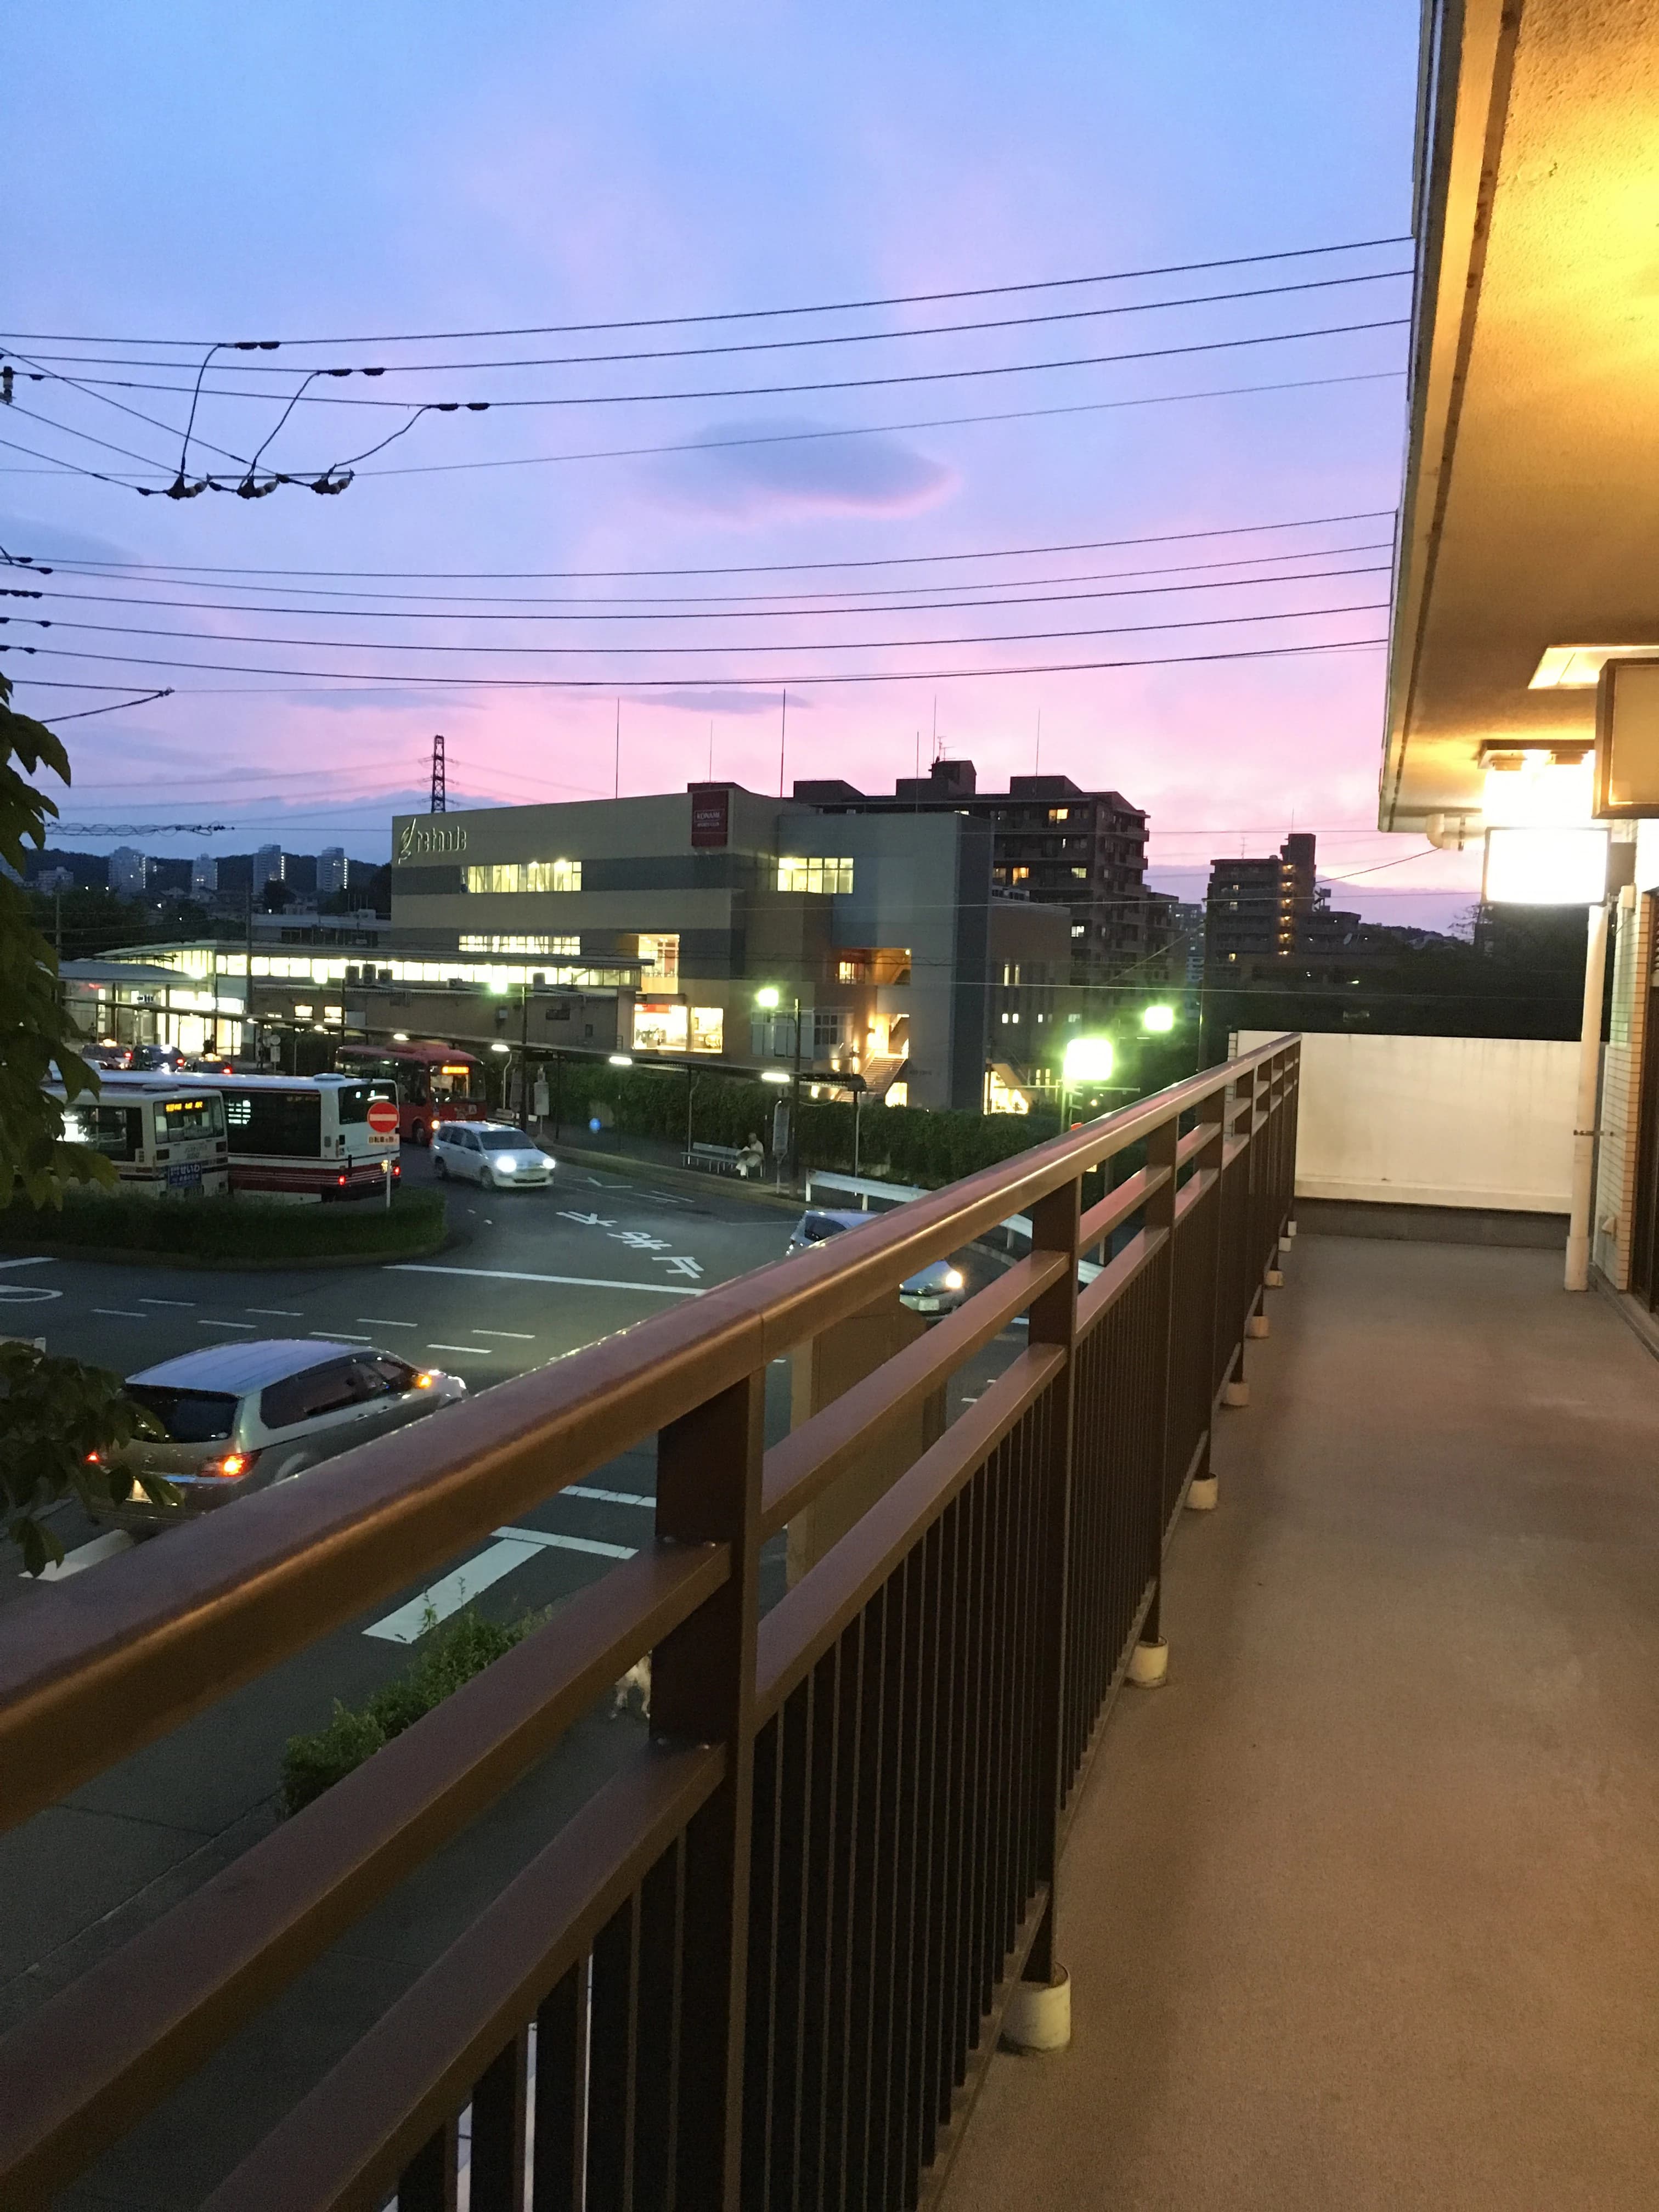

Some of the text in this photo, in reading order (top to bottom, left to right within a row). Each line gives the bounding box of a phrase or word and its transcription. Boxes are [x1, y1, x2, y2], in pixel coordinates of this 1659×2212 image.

[180, 1164, 200, 1174] せいわ
[556, 1211, 704, 1279] 止まれ
